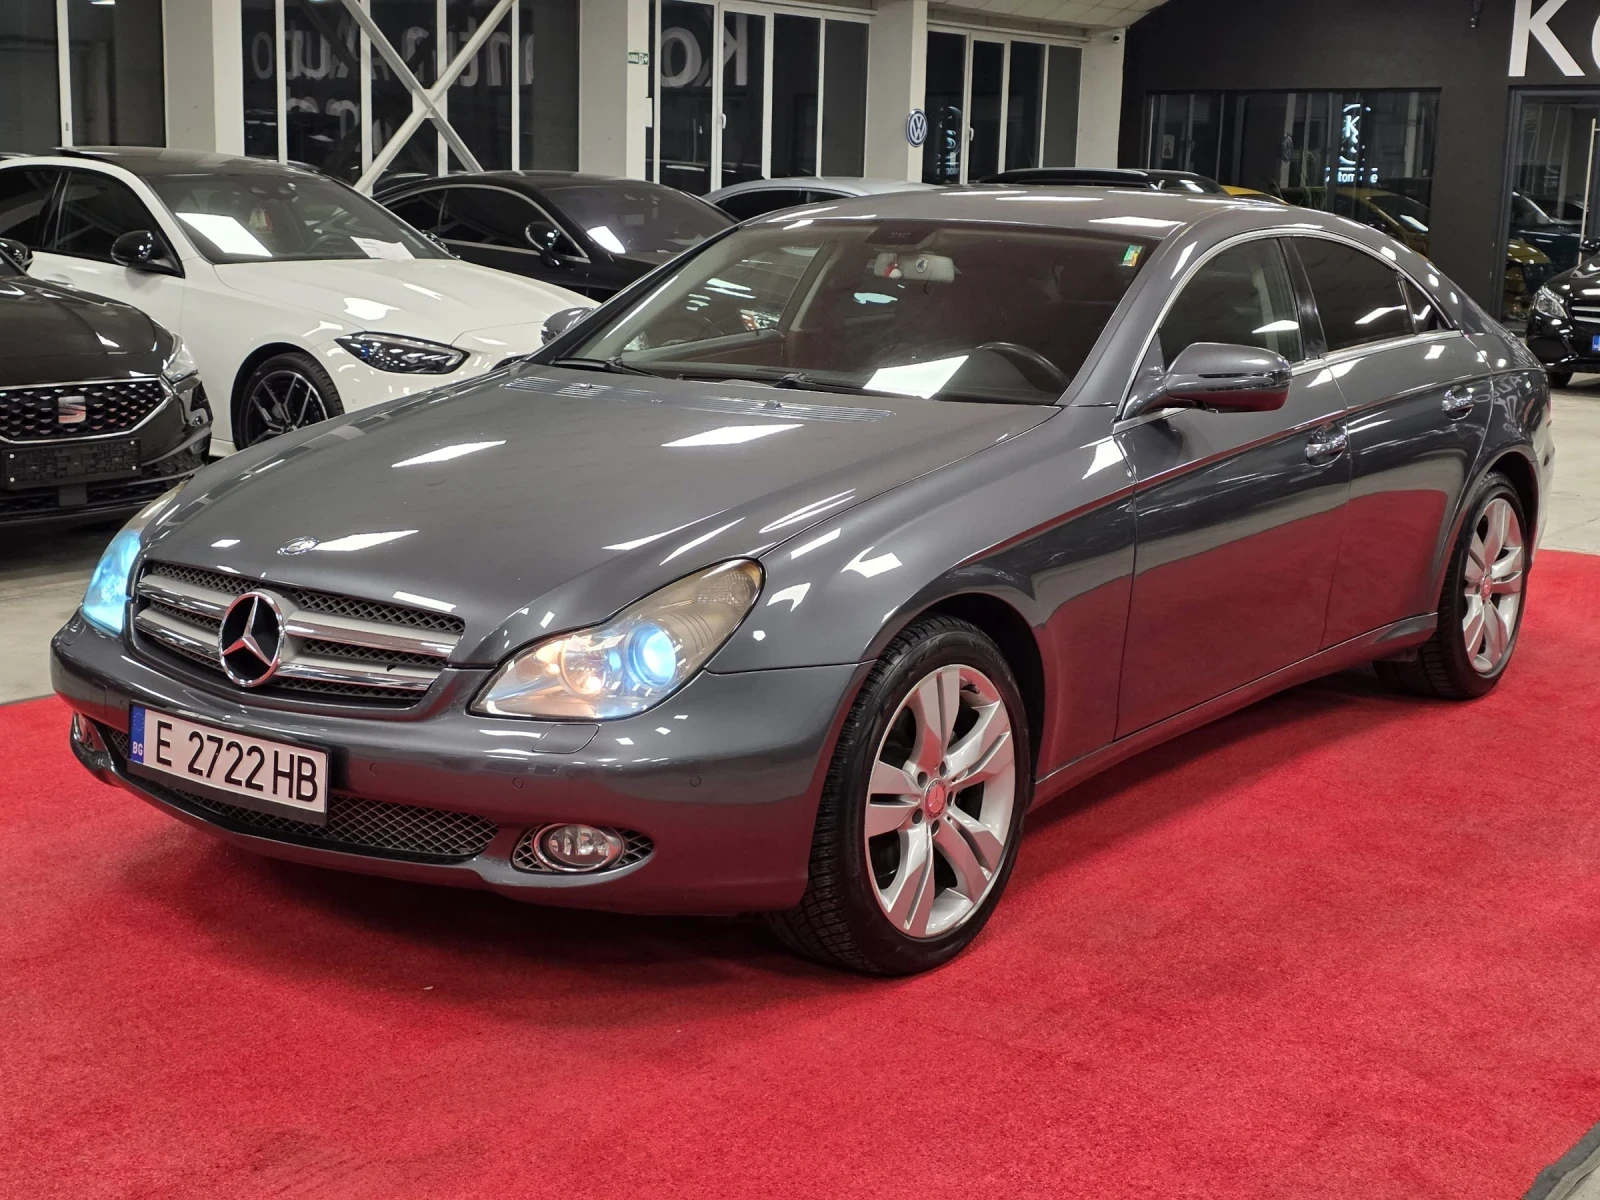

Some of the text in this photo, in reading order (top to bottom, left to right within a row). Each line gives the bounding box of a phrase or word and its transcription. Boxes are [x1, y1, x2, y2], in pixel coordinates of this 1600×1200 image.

[132, 741, 144, 756] BG
[156, 719, 318, 802] E 2722 HB
